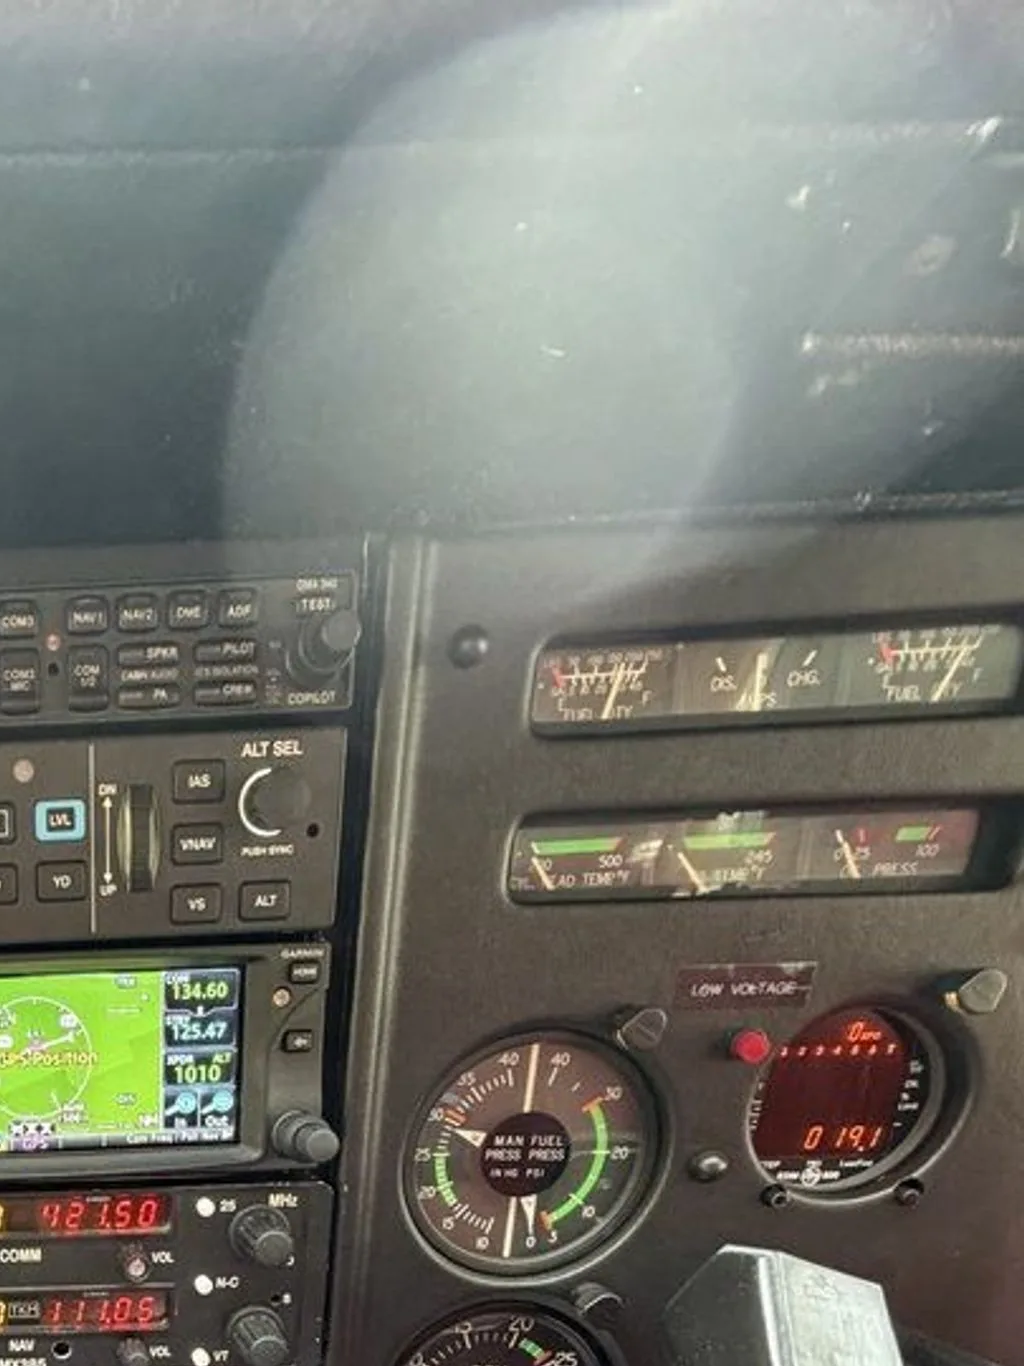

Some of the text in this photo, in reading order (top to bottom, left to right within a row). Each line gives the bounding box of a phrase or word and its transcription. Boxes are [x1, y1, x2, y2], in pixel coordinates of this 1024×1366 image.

[226, 604, 252, 618] ADF
[301, 597, 331, 612] TEST
[73, 611, 103, 623] NAV1
[122, 609, 154, 622] NAV2
[176, 606, 202, 619] DME
[0, 614, 35, 628] COM3
[287, 690, 337, 705] COPILOT
[240, 739, 305, 758] ALT SEL
[187, 773, 212, 788] IAS
[48, 812, 72, 826] LVL
[179, 836, 217, 851] VNAV
[598, 854, 624, 869] 500
[872, 860, 920, 876] PRESS
[52, 874, 72, 889] YD
[187, 898, 207, 912] VS
[254, 893, 278, 908] ALT
[172, 981, 229, 1000] 134.60
[691, 980, 798, 997] LOW VOLTAGE
[171, 1021, 228, 1041] 125.47
[32, 1049, 99, 1068] Position
[497, 1053, 520, 1066] 40
[551, 1052, 571, 1066] 40
[174, 1064, 222, 1084] 1010
[494, 1135, 525, 1147] MAN
[530, 1135, 564, 1147] FUEL
[484, 1149, 522, 1161] PRESS
[528, 1148, 565, 1161] PRESS
[610, 1147, 629, 1160] 20
[219, 1200, 236, 1213] 25
[268, 1193, 299, 1208] MHz
[582, 1206, 596, 1218] 10
[525, 1237, 536, 1248] 0
[151, 1252, 175, 1264] VOL
[47, 1296, 156, 1324] 111.05
[508, 1316, 536, 1332] 20
[8, 1338, 35, 1352] NAV
[148, 1346, 173, 1359] VOL
